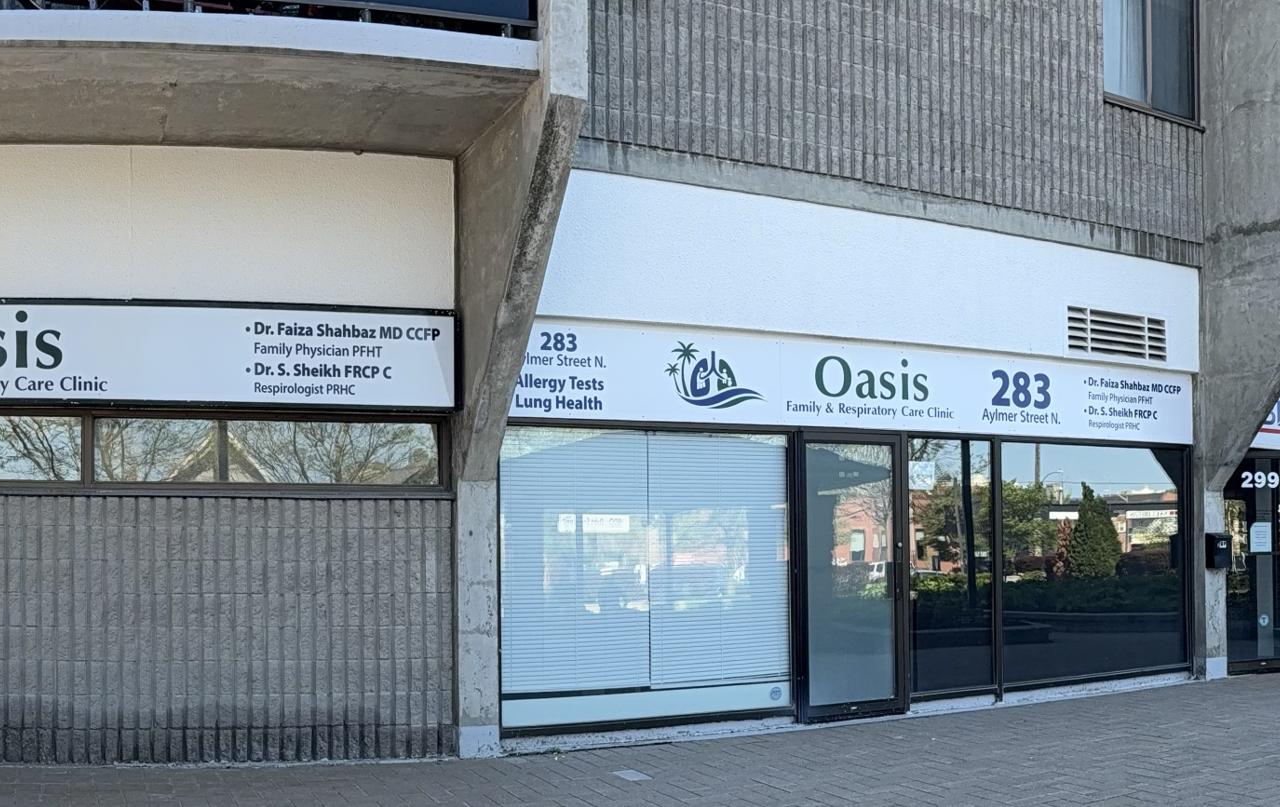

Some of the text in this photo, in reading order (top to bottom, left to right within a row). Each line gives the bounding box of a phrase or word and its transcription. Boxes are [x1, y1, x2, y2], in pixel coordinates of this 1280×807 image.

[254, 322, 440, 341] Dr. Faiza Shahbaz MD CCFP
[540, 332, 577, 352] 283
[254, 343, 382, 358] Family Physician PFHT
[525, 352, 606, 368] lmer Street N.
[254, 363, 392, 379] Dr. S. Sheikh FRCP C
[815, 355, 929, 401] Oasis
[15, 376, 53, 391] Care
[60, 376, 108, 392] Clinic
[254, 382, 356, 397] Respirologist PRHC
[517, 373, 604, 393] Allergy Tests
[991, 369, 1051, 409] 283
[1088, 377, 1181, 394] Dr. Faiza Shahbaz MD CCFP
[515, 394, 602, 412] Lung Health
[1088, 391, 1153, 404] Family Physician PFHT
[786, 401, 954, 419] Family & Respiratory Care Clinic
[982, 408, 1061, 424] Aylmer Street N.
[1088, 406, 1158, 420] Dr. S. Sheikh FRCP C
[1088, 420, 1124, 430] Respirologist
[1241, 471, 1280, 488] 299
